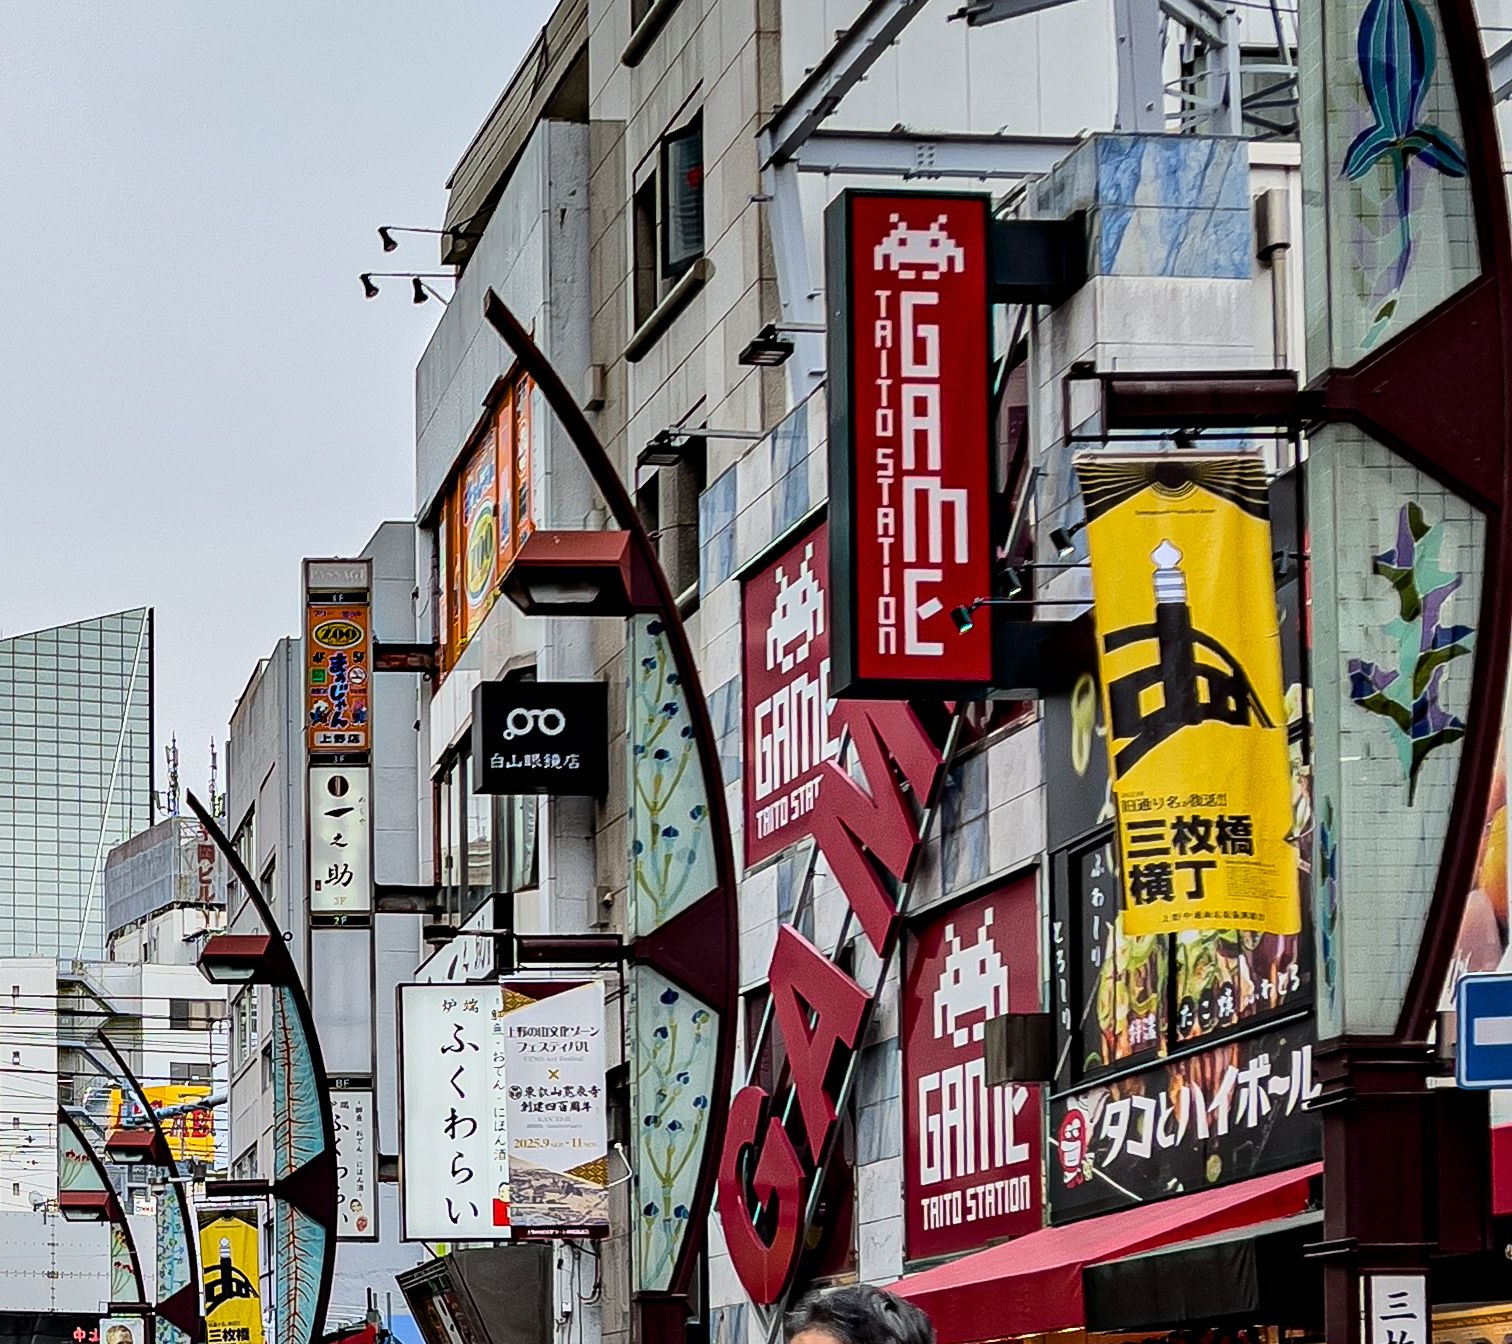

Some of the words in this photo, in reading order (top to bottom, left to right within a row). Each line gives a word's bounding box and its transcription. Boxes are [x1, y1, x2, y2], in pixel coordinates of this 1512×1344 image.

[874, 289, 894, 437] TAITO
[899, 291, 970, 657] GAME
[876, 448, 897, 655] STATION
[490, 752, 581, 769] 白山眼鏡店
[323, 806, 356, 888] 一之助
[756, 792, 788, 841] TAITO
[1127, 814, 1255, 858] 三枚橋
[1129, 860, 1217, 905] 横丁
[516, 1041, 590, 1054] フェスティバル
[440, 1022, 480, 1225] ふくわらい
[918, 1063, 1030, 1187] GAME
[1099, 1044, 1323, 1169] タコとハイボール
[921, 1188, 963, 1231] TAITO
[964, 1173, 1031, 1223] STATION
[208, 1327, 251, 1343] 三枚橋
